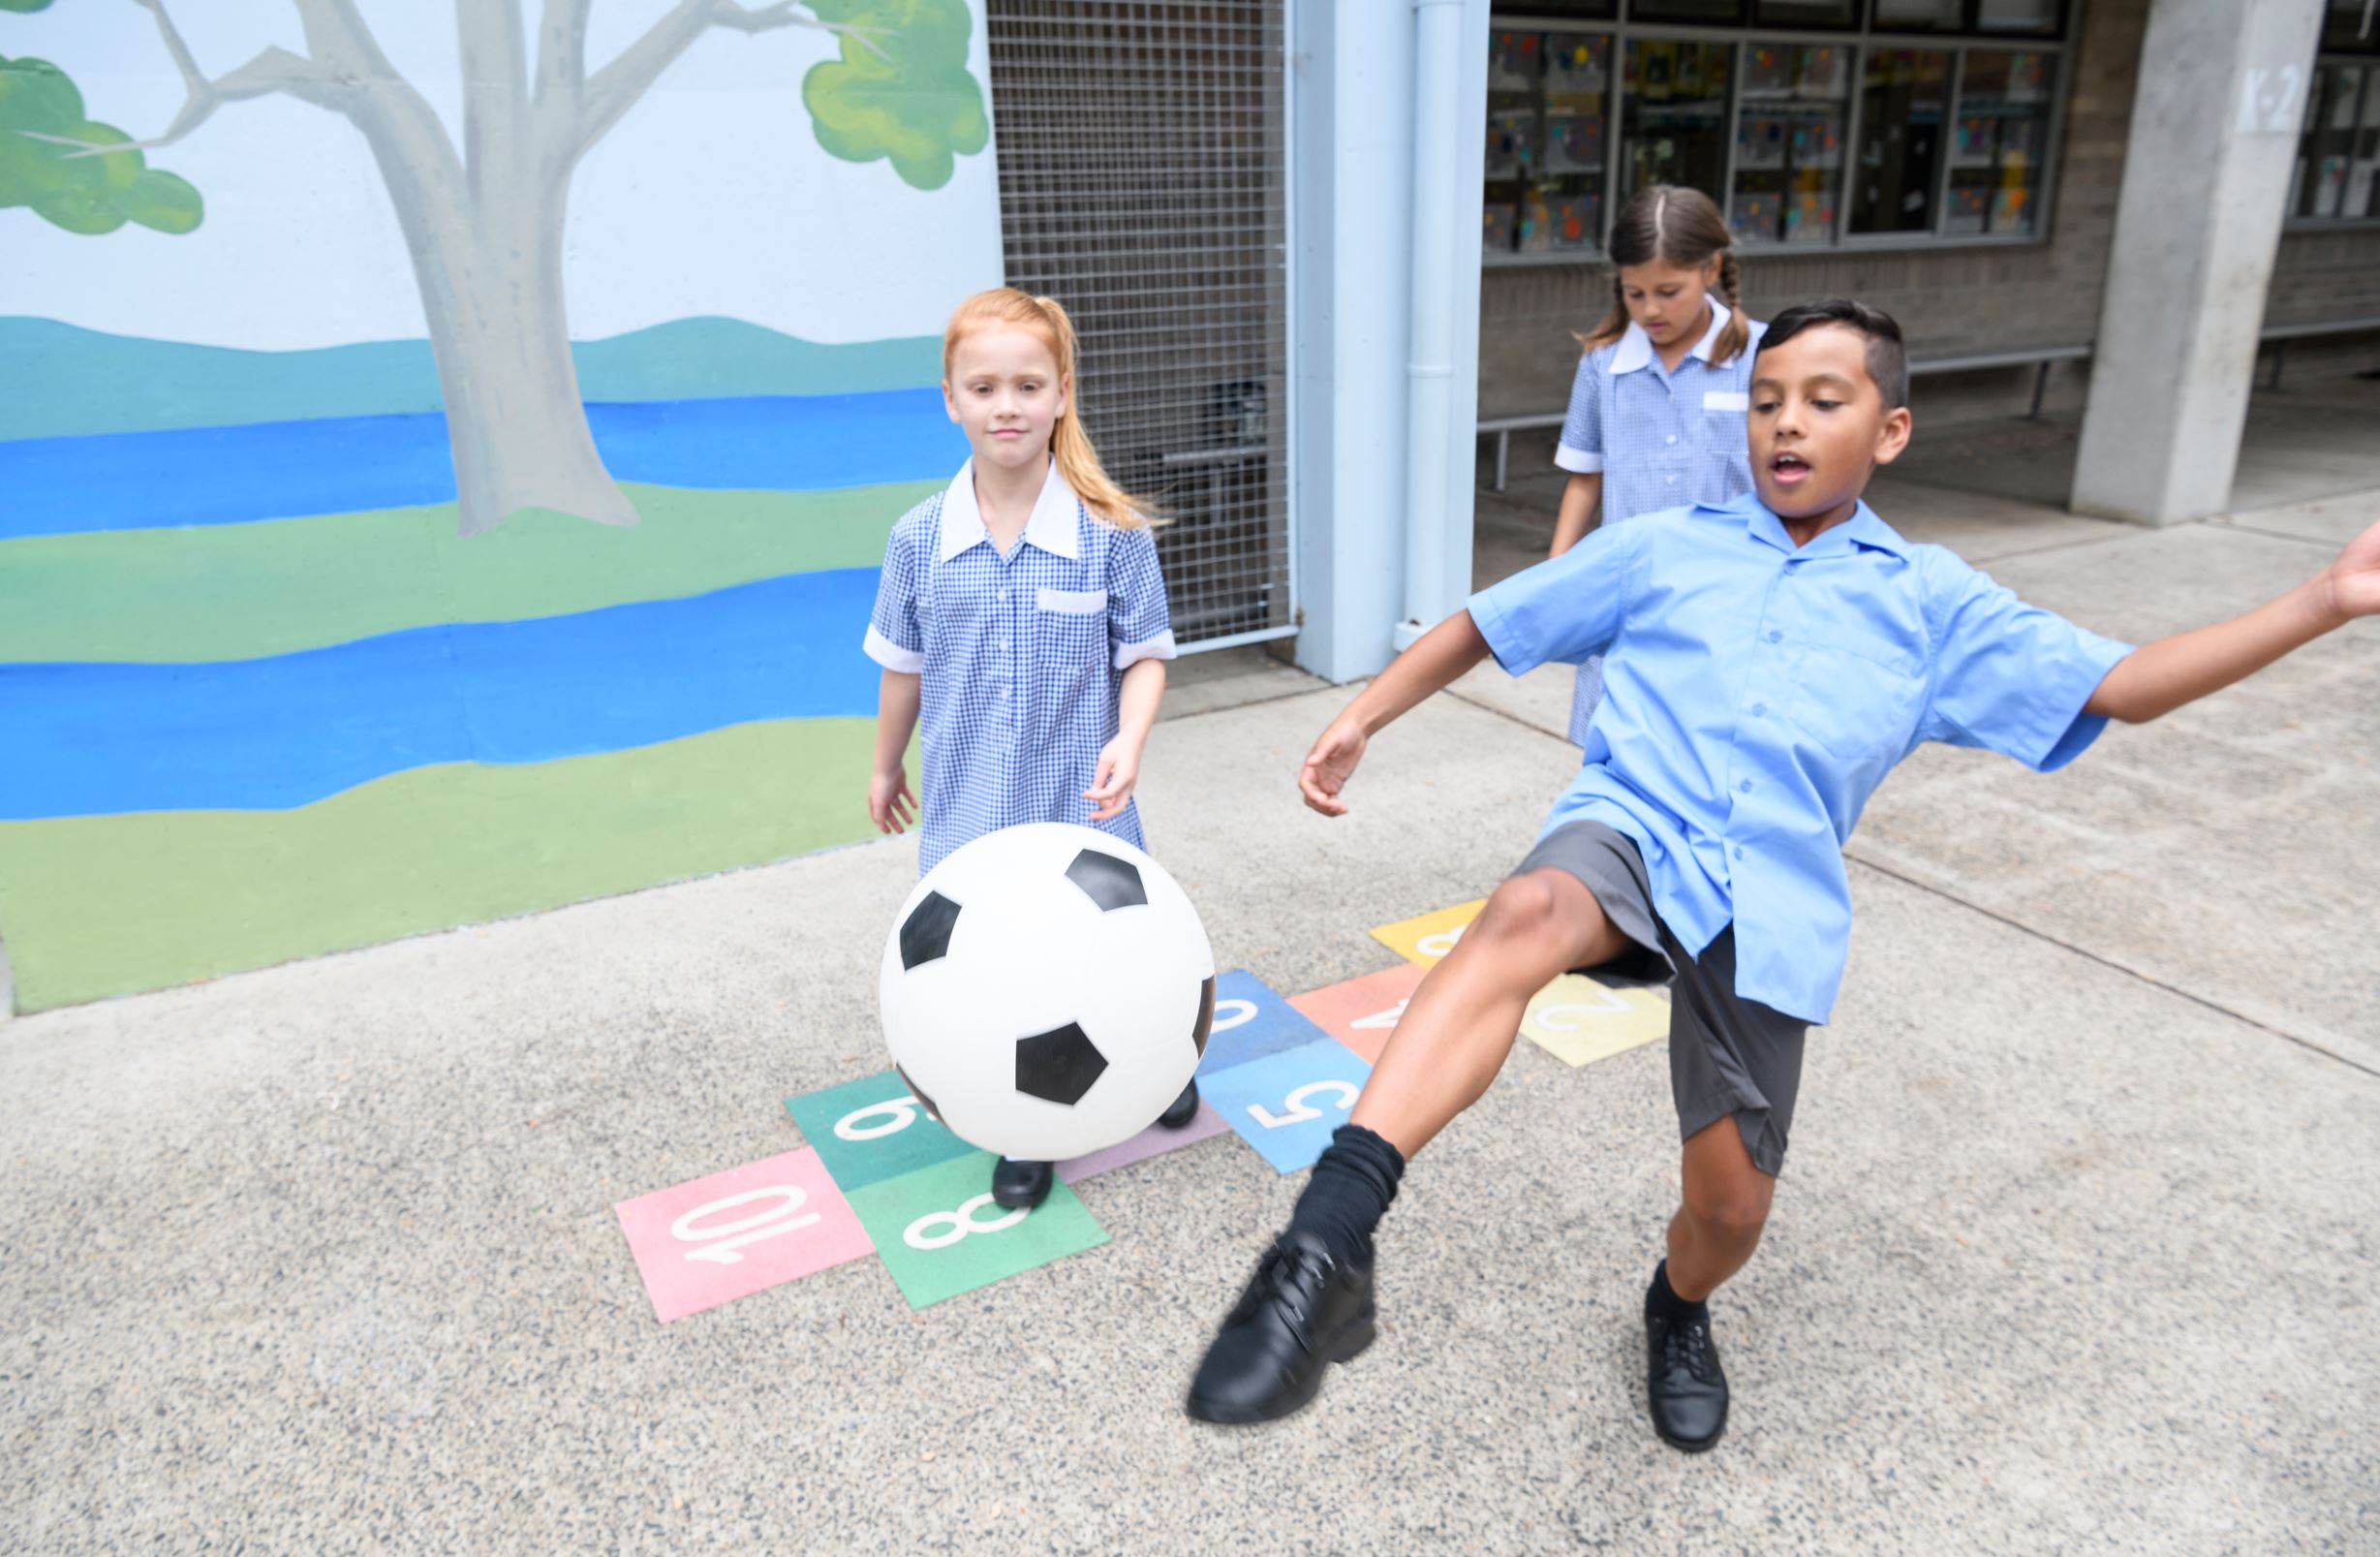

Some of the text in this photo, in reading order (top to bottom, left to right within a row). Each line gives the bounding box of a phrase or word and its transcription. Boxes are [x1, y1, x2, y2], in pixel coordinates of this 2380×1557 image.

[1535, 989, 1635, 1031] 2
[1245, 1080, 1361, 1129] 5
[671, 1184, 821, 1263] 10
[902, 1192, 1032, 1251] 8
